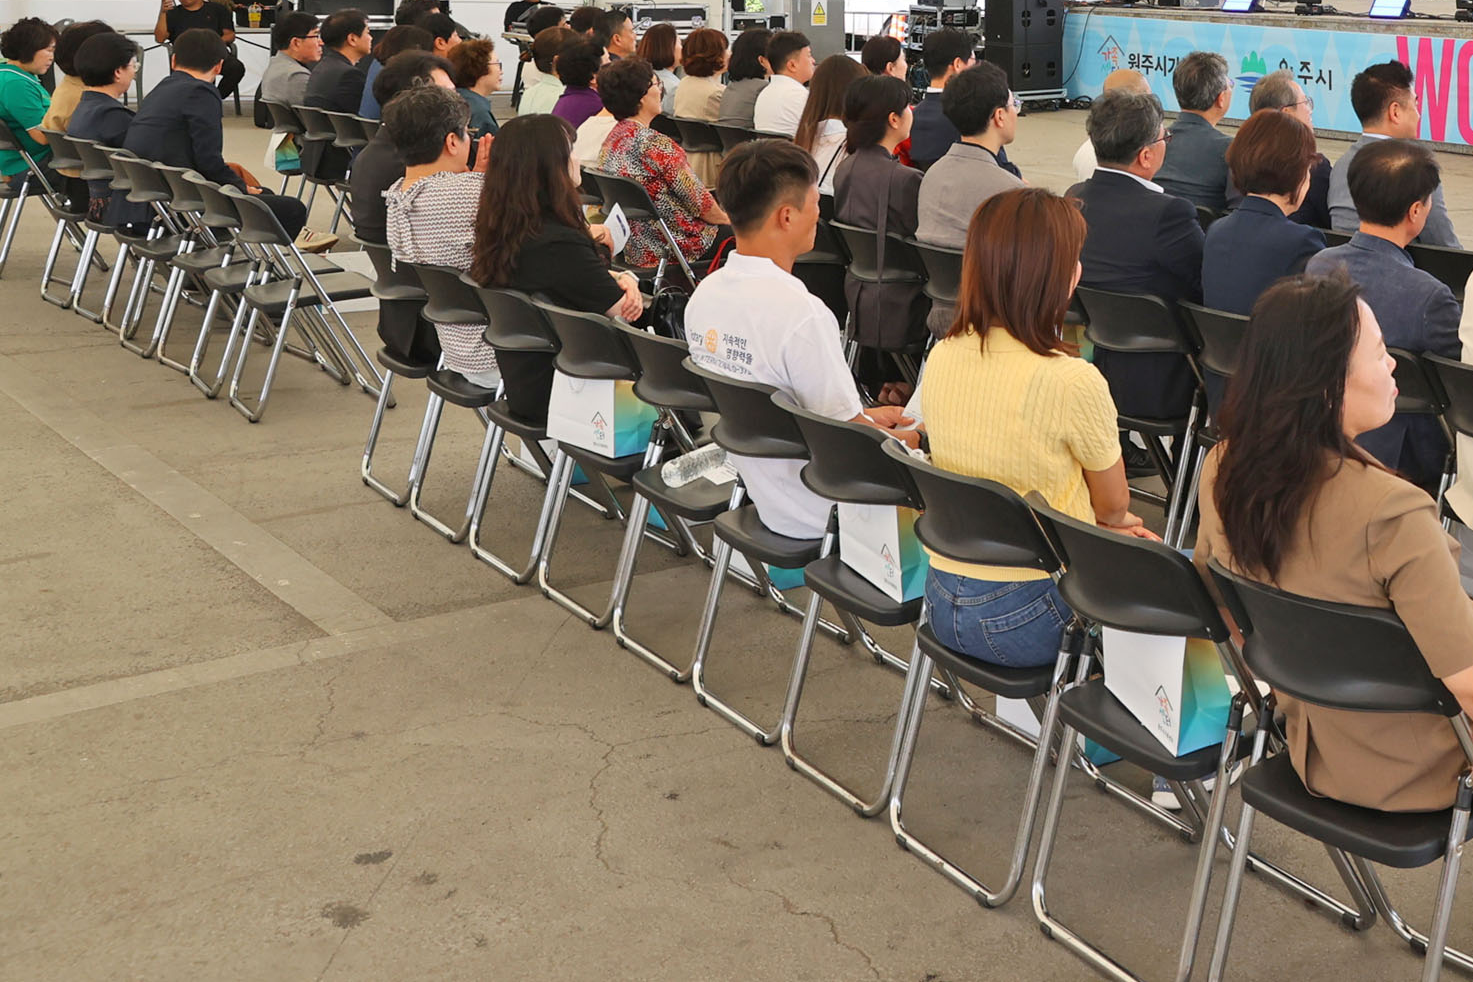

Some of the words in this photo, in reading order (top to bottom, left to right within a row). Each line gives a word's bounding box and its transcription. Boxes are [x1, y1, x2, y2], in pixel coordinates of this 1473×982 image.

[1128, 52, 1180, 77] 원주시가
[722, 333, 748, 351] 지속적인
[727, 348, 753, 366] 영향력을
